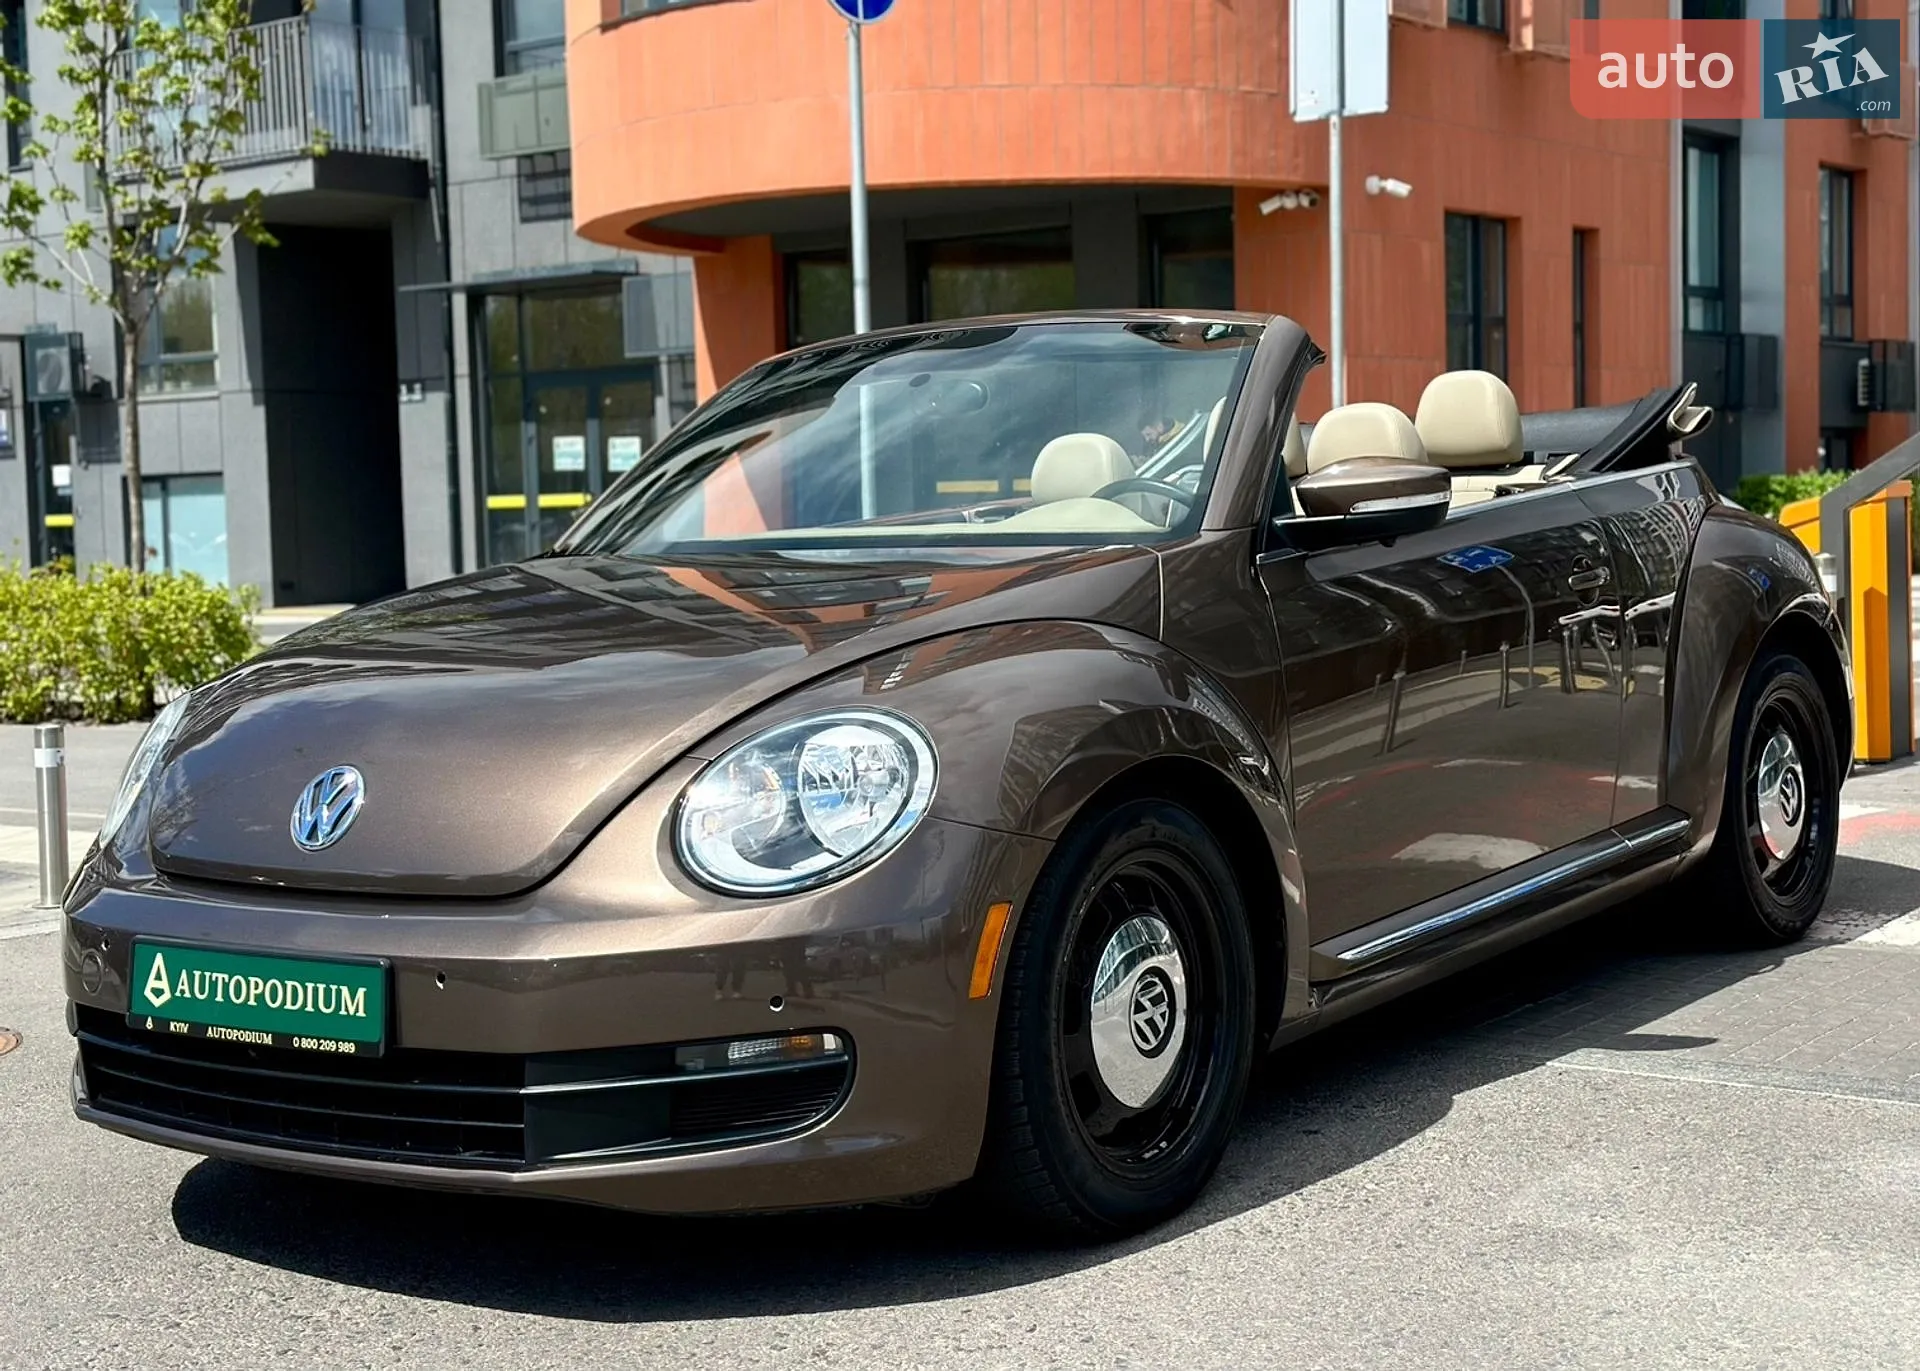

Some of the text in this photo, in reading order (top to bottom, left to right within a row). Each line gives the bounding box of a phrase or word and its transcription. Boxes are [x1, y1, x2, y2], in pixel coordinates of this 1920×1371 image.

[174, 968, 368, 1018] AUTOPODIUM
[169, 1021, 356, 1054] KYIV AUTOPODIUM 0 800 209 989
